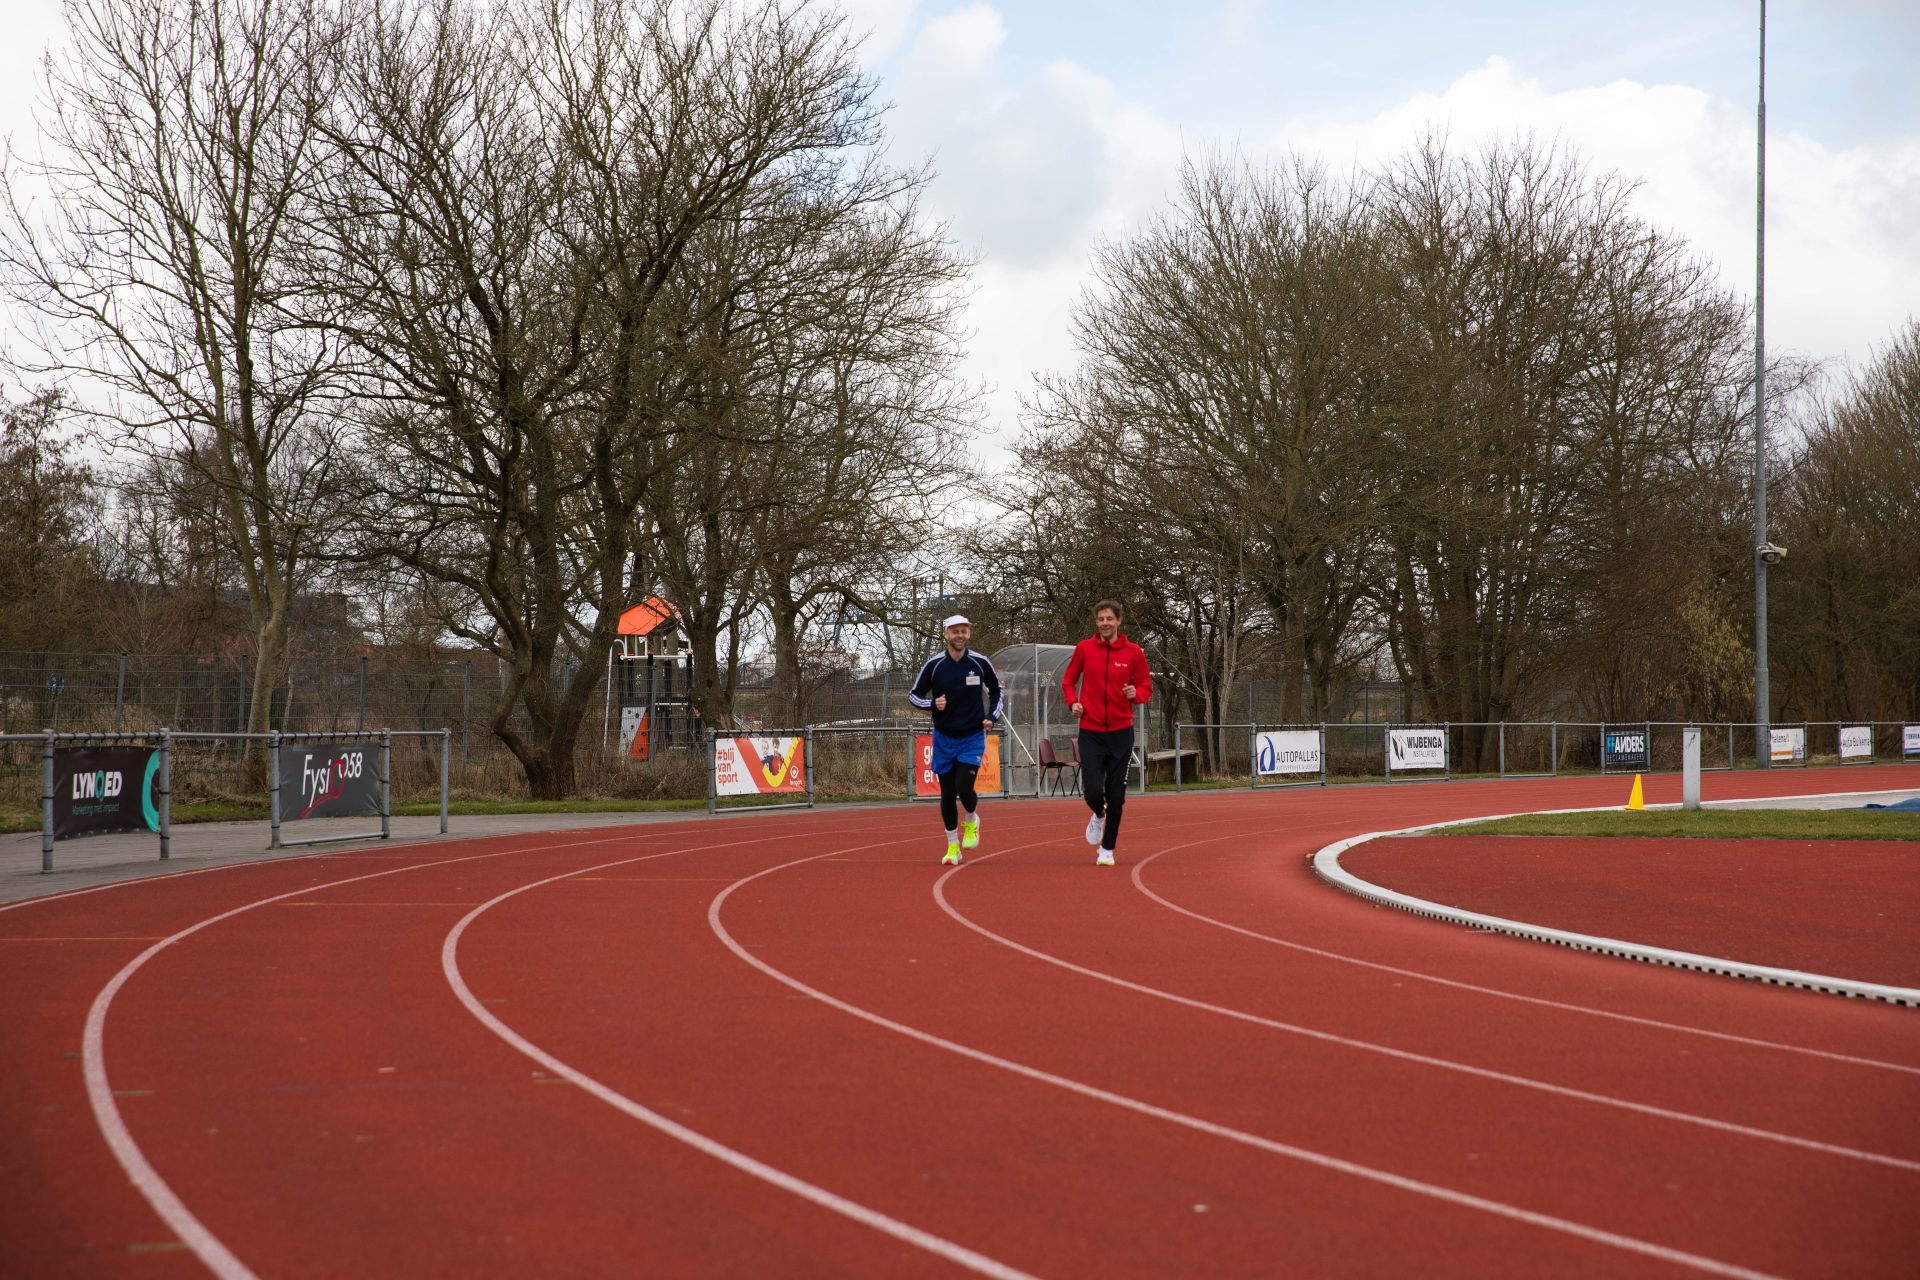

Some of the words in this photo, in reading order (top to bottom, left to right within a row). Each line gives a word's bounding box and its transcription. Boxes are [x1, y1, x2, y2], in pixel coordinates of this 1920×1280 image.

[1407, 736, 1443, 749] WIJBENGA
[1276, 750, 1318, 763] AUTOPALLAS
[717, 764, 731, 772] van
[72, 770, 122, 801] LYNQED
[718, 772, 738, 787] sport
